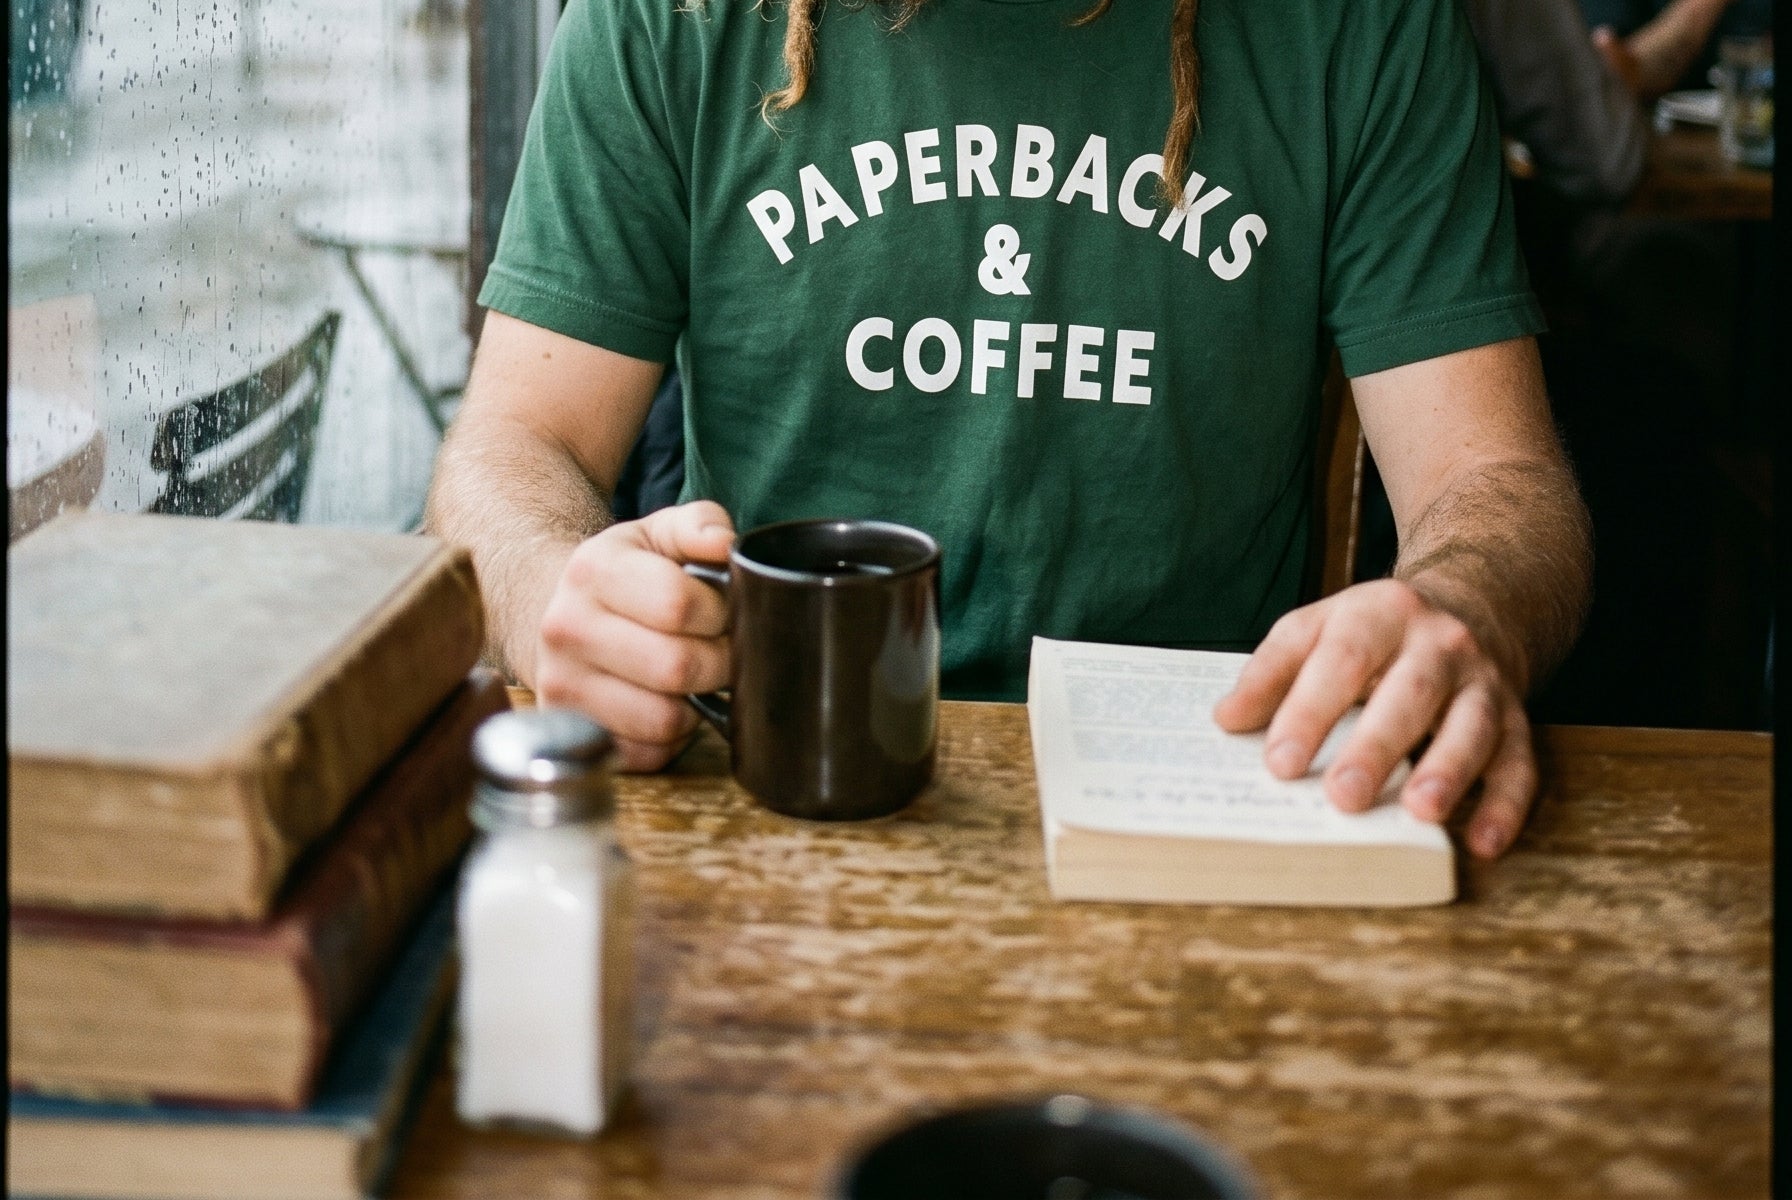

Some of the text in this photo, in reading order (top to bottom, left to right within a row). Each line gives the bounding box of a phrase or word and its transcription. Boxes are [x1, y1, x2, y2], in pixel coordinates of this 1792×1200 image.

[746, 123, 1268, 281] PAPERBACKS
[977, 223, 1032, 296] &
[845, 316, 1156, 405] COFFEE
